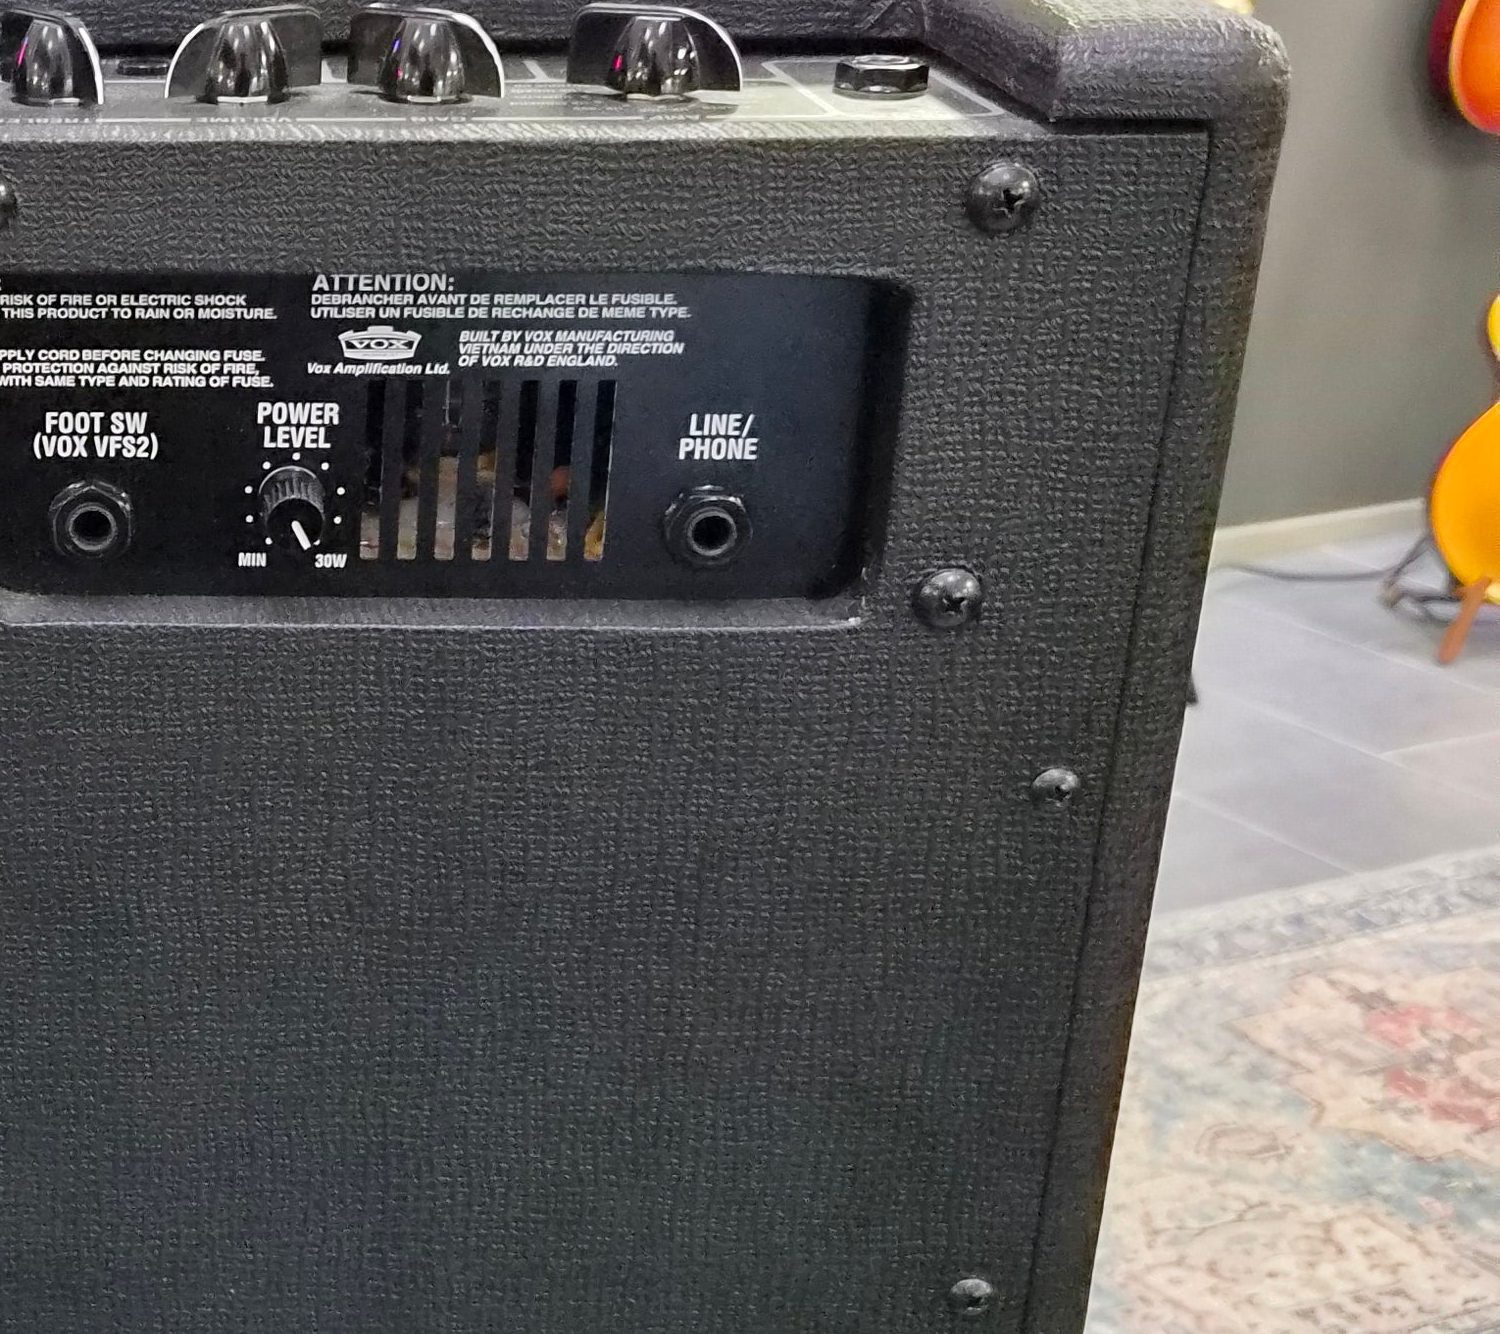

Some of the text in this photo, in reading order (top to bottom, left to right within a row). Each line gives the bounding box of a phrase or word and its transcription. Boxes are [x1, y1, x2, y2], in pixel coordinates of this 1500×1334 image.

[312, 274, 454, 292] ATTENTION:
[0, 294, 34, 306] RISK
[35, 294, 57, 306] OF
[59, 294, 93, 306] FIRE
[95, 294, 118, 306] OR
[120, 294, 192, 306] ELECTRIC
[193, 294, 247, 306] SHOCK
[311, 294, 677, 306] DEBRANCHER AVANT DE REMPLACER LE FUSIBLE.
[1, 307, 35, 320] THIS
[36, 307, 109, 320] PRODUCT
[110, 307, 132, 320] TO
[134, 307, 170, 320] RAIN
[172, 307, 195, 320] OR
[197, 307, 277, 320] MOISTURE.
[310, 307, 691, 319] UTILISER UN FUSIBLE DE RECHANGE DE MEME TYPE.
[459, 331, 675, 343] BUILT BY VOX MANUFACTURING
[348, 338, 409, 350] VOX
[458, 343, 684, 355] VIETNAM UNDER THE DIRECTION
[37, 349, 80, 362] CORD
[81, 349, 141, 362] BEFORE
[143, 349, 221, 362] CHANGING
[223, 349, 266, 362] FUSE.
[457, 356, 619, 368] OF VOX R&D ENGLAND.
[2, 362, 95, 375] PROTECTION
[96, 362, 161, 376] AGAINST
[162, 362, 198, 376] RISK
[199, 362, 221, 376] OF
[222, 362, 260, 376] FIRE,
[305, 363, 451, 376] Vox Amplification Ltd.
[34, 375, 76, 388] SAME
[77, 375, 116, 388] TYPE
[117, 375, 150, 388] AND
[151, 375, 207, 388] RATING
[208, 375, 230, 388] OF
[231, 375, 274, 388] FUSE.
[256, 401, 340, 426] POWER
[45, 411, 149, 435] FOOT SW
[688, 413, 756, 438] LINE/
[263, 426, 331, 449] LEVEL
[32, 433, 159, 460] (VOX VFS2)
[678, 437, 760, 460] PHONE
[238, 552, 267, 567] MIN
[314, 553, 348, 568] 30W
